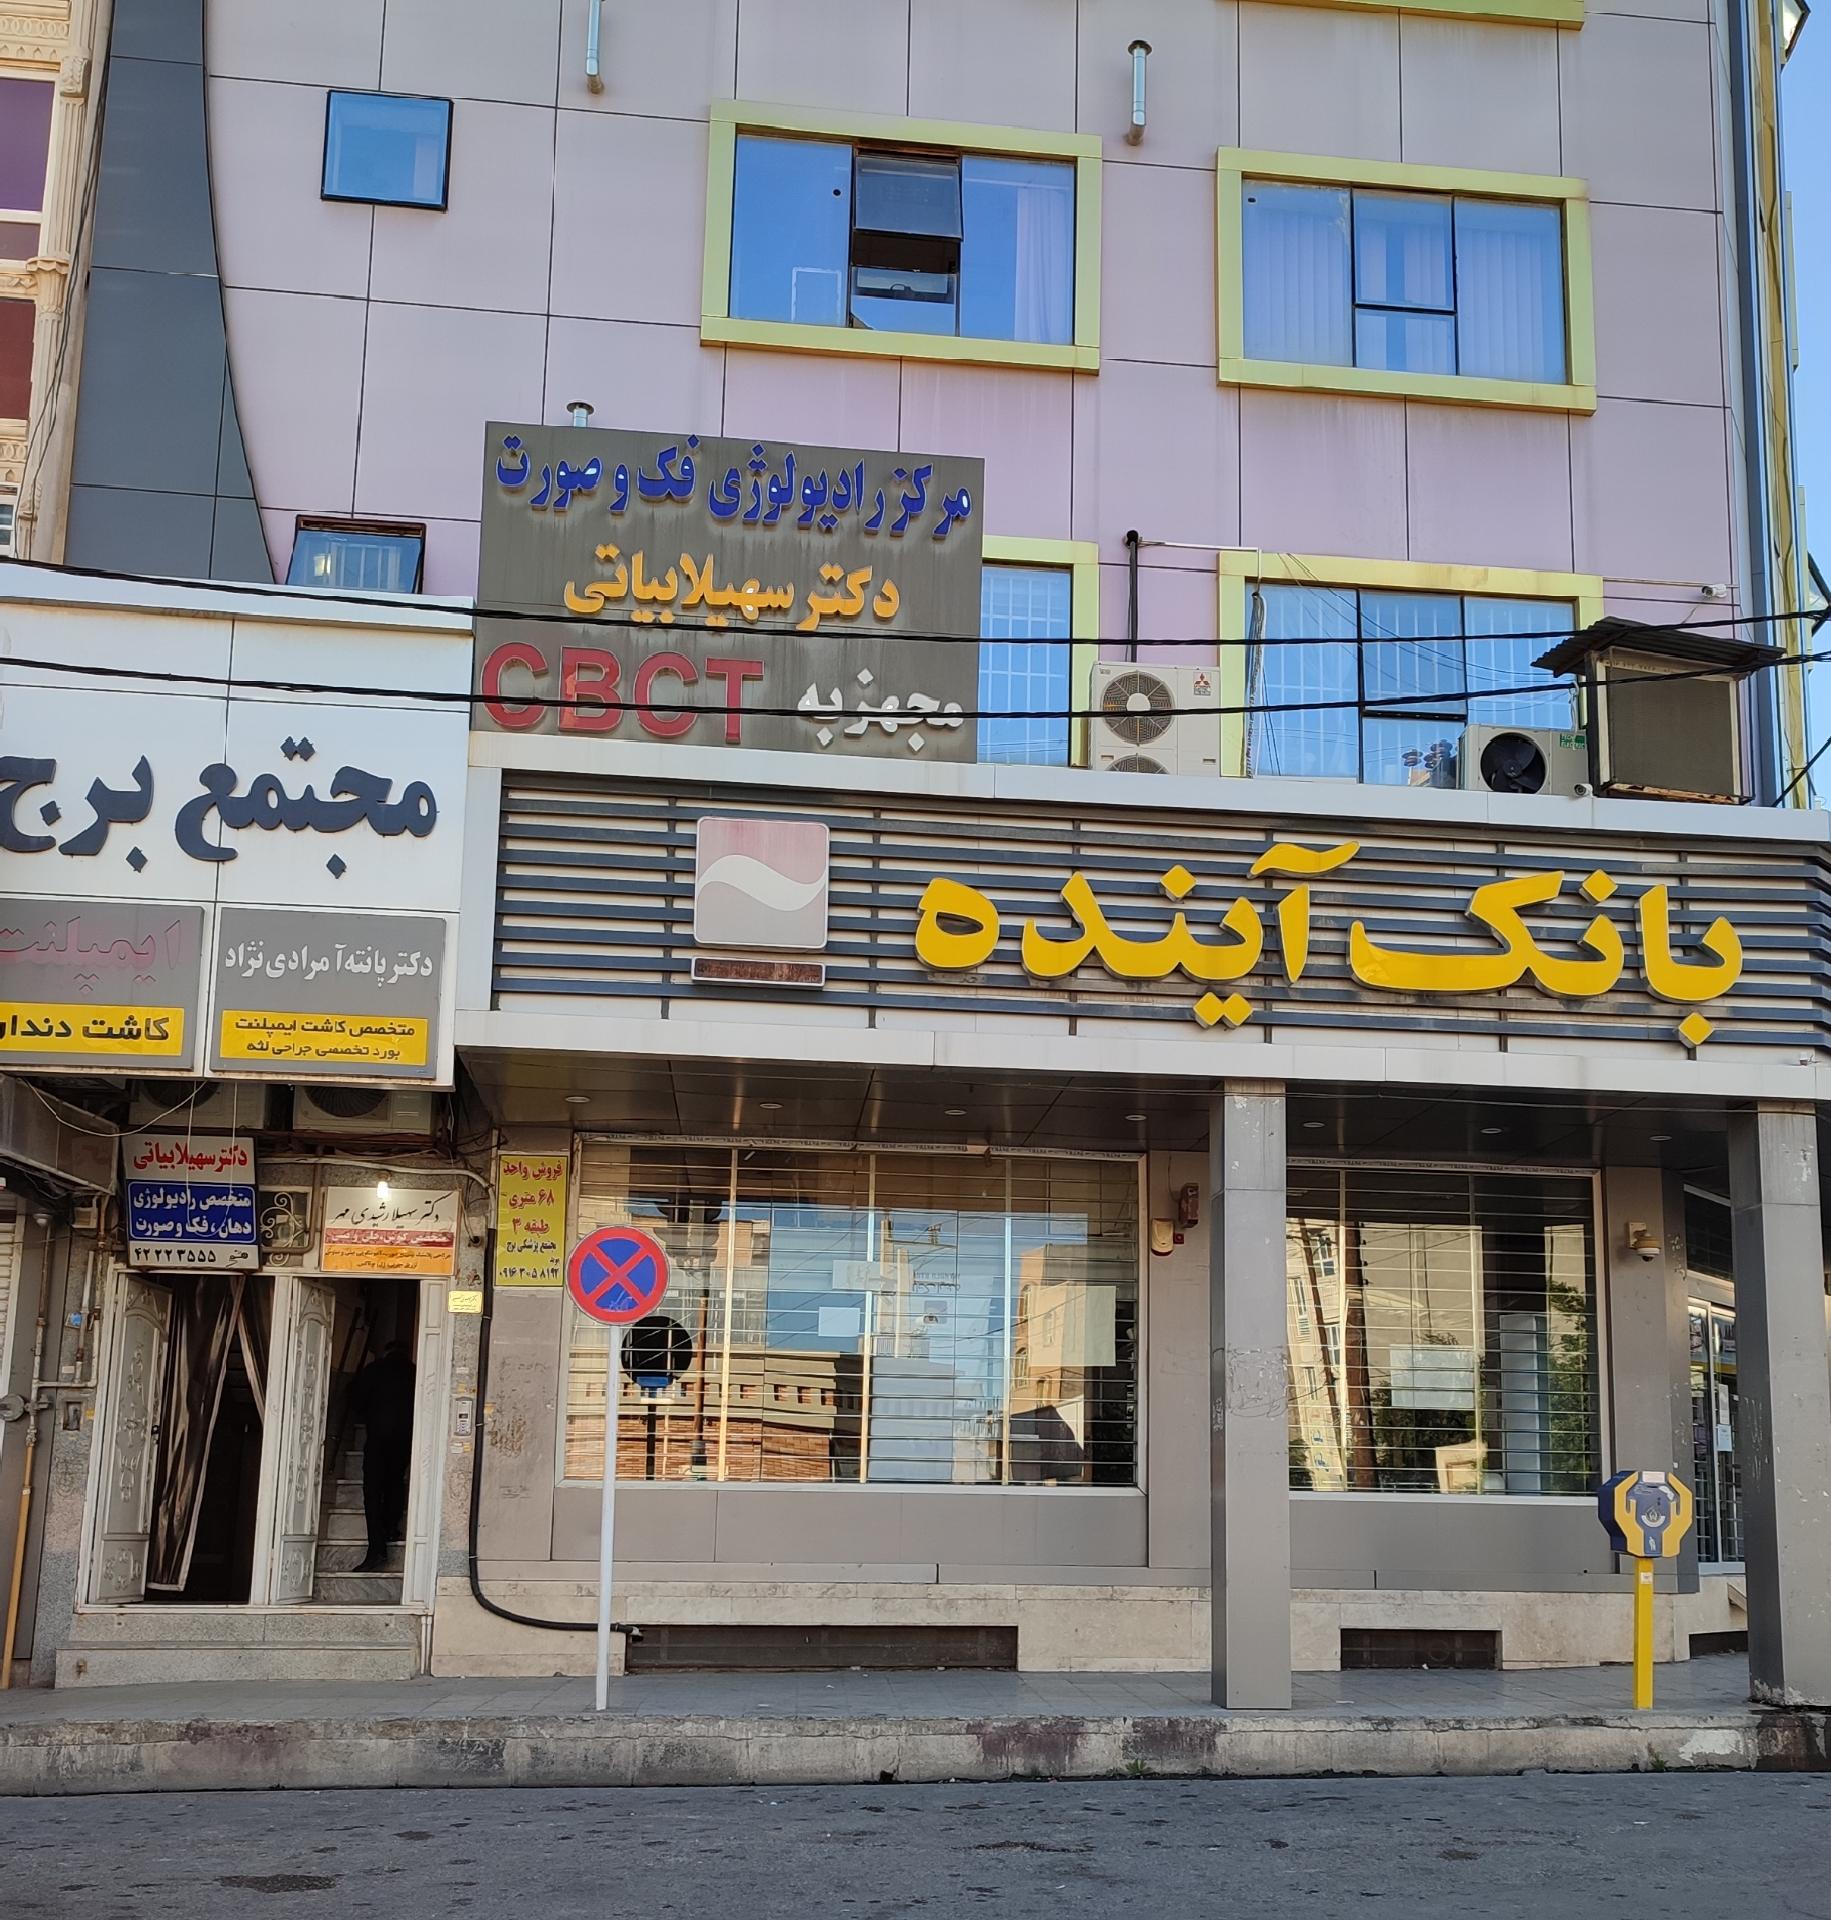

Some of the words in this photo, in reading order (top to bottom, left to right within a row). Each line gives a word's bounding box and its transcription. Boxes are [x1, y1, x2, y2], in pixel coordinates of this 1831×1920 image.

[496, 433, 602, 511] صورت
[637, 434, 700, 499] فک
[609, 461, 631, 513] و
[709, 442, 886, 533] رادیولوژی
[891, 463, 972, 538] مرکز
[564, 544, 678, 624] بیاتی
[681, 553, 795, 626] سهیلا
[797, 561, 899, 630] دکتر
[479, 640, 765, 744] CBCT
[797, 681, 842, 747] به
[844, 668, 965, 752] مجهز
[0, 755, 154, 873] برج
[175, 736, 437, 879] مجتمع
[914, 841, 1362, 1029] آینده
[387, 950, 432, 984] دکتر
[1348, 869, 1743, 1049] بانک
[82, 1014, 170, 1041] کاشت
[235, 1017, 297, 1037] ایمپلنت
[301, 1019, 346, 1032] کاشت
[349, 1022, 415, 1037] متخصص
[272, 1041, 311, 1056] جراحی
[315, 1044, 369, 1057] تخصصی
[372, 1047, 400, 1060] بورد
[133, 1141, 175, 1169] بیاتی
[175, 1142, 215, 1170] سهیلا
[215, 1145, 248, 1172] دکتر
[532, 1160, 562, 1180] فروش
[503, 1161, 529, 1180] واحد
[133, 1187, 197, 1210] رادیولوژی
[200, 1189, 252, 1210] متخصص
[416, 1192, 453, 1225] دکتر
[509, 1192, 535, 1209] متری
[185, 1215, 208, 1233] فک
[524, 1219, 550, 1238] طبقه
